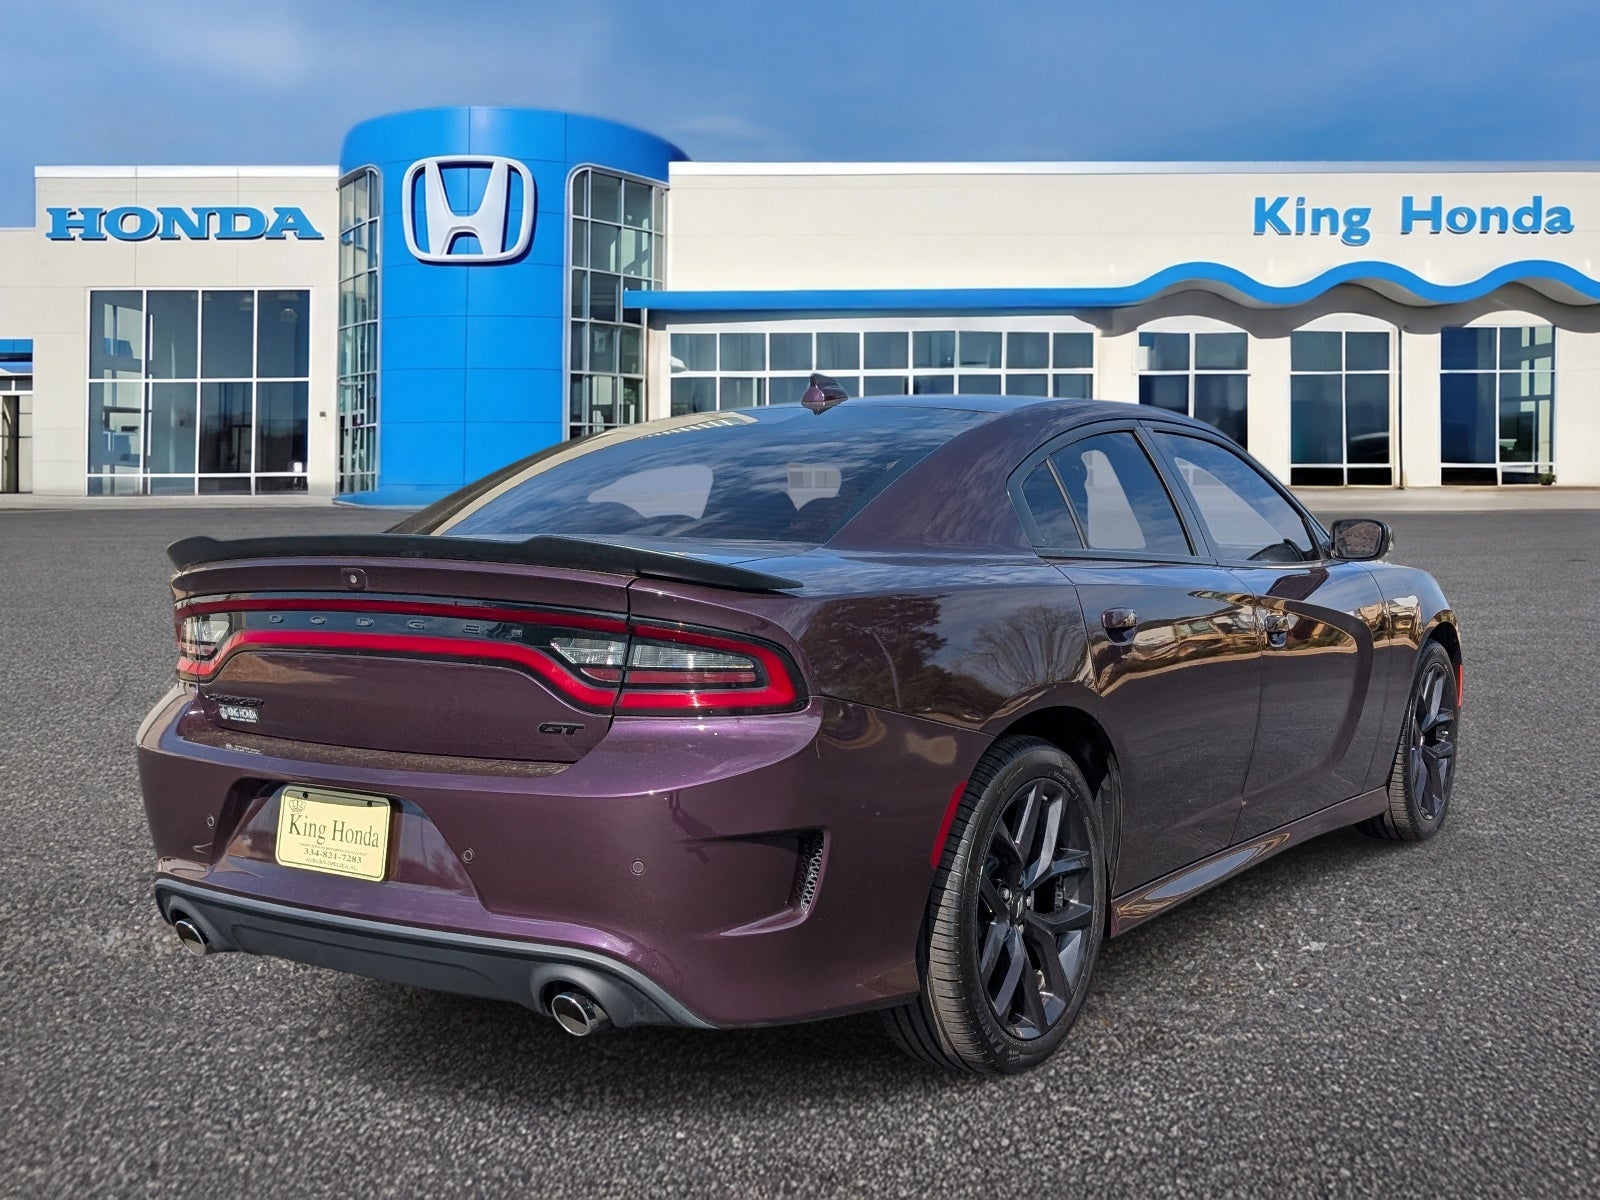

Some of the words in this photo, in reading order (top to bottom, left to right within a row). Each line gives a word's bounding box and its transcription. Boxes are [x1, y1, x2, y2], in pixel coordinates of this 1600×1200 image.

[46, 207, 323, 241] HONDA
[1254, 196, 1371, 246] King
[1401, 195, 1574, 234] Honda
[268, 613, 480, 636] DODGE
[539, 722, 585, 736] GT
[288, 813, 328, 845] King
[331, 819, 380, 849] Honda
[303, 847, 362, 864] 334-821-7283
